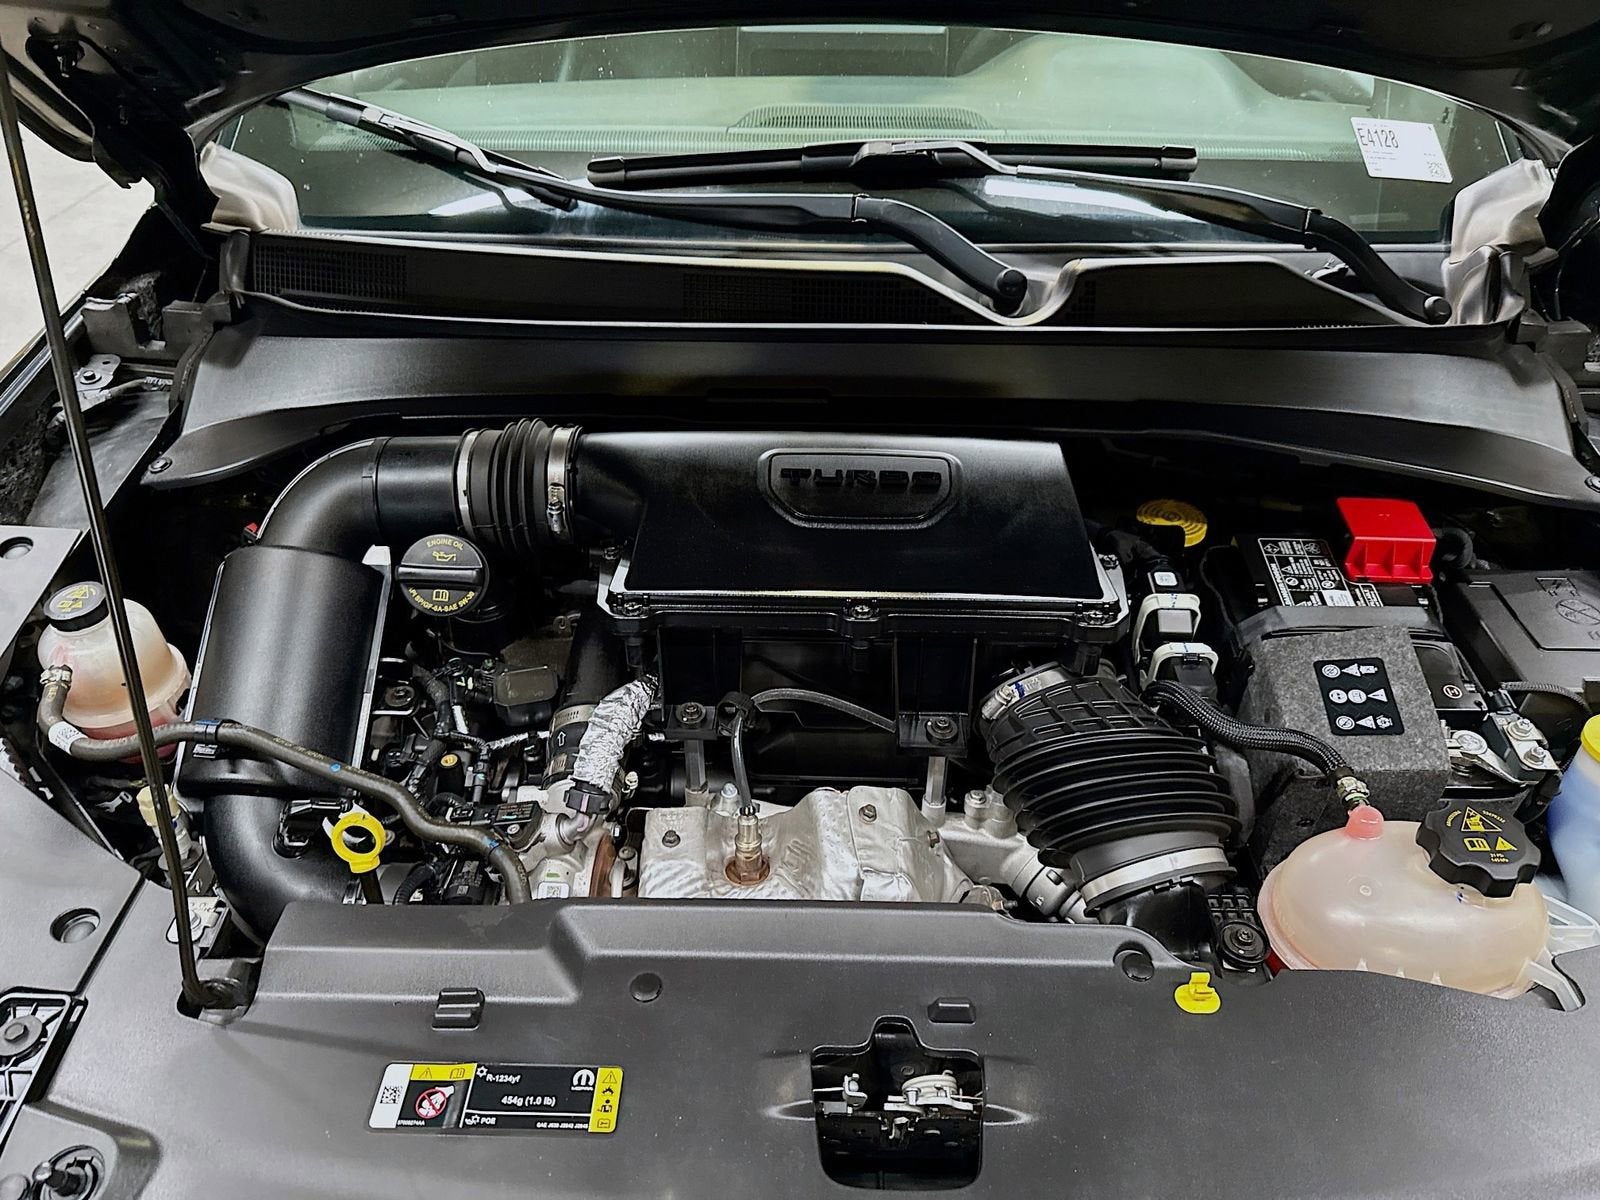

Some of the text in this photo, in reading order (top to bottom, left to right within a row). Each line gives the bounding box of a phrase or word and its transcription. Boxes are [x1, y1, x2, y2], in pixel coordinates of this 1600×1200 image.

[1357, 127, 1399, 148] E4128
[780, 468, 943, 493] TURBO
[426, 538, 464, 551] ENGINE OIL
[486, 1073, 521, 1085] R-1234yf
[501, 1095, 556, 1108] 454g (1.0 lb)
[480, 1117, 496, 1125] POE
